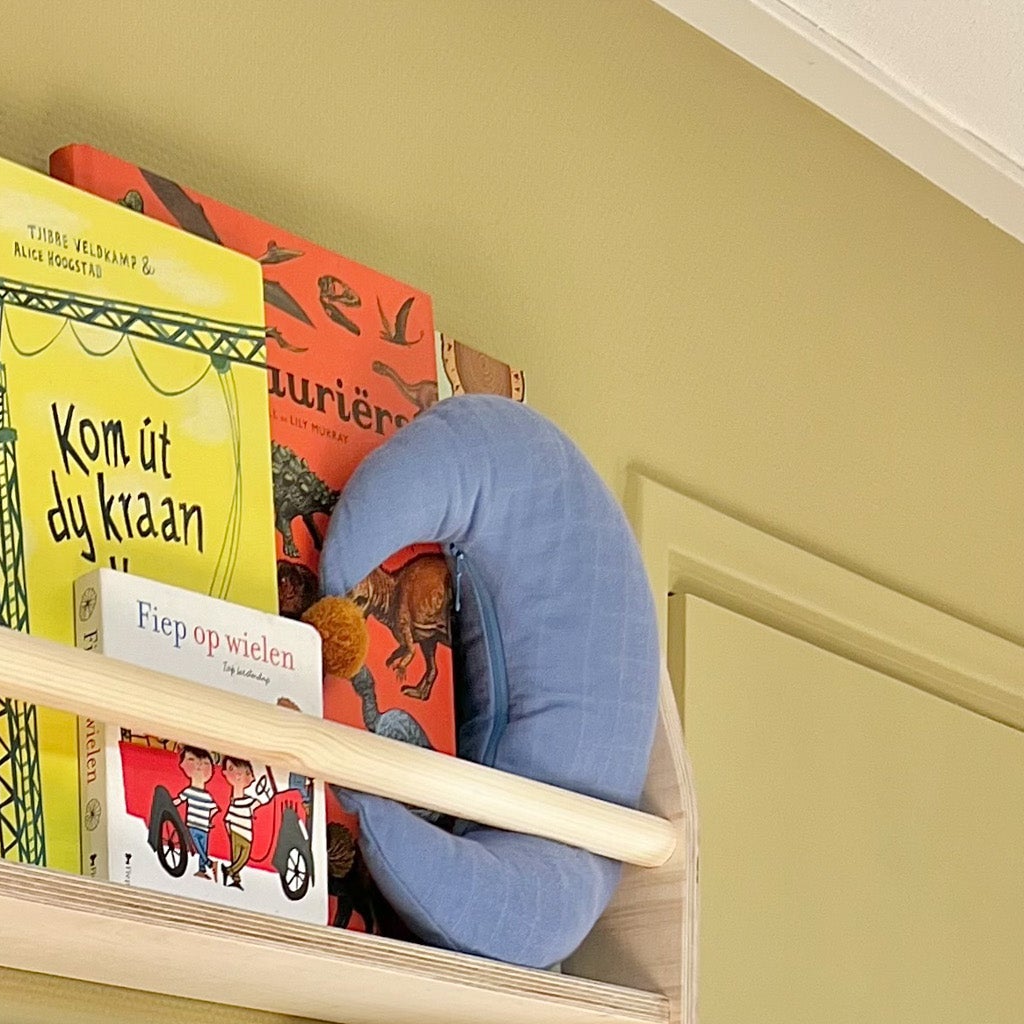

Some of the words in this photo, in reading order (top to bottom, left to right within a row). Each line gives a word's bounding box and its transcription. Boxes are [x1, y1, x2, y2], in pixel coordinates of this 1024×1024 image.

[14, 242, 43, 262] ALICE
[48, 252, 102, 279] HOOGSTAD
[27, 225, 68, 249] TJIBBE
[74, 238, 137, 269] VELDKAMP
[141, 256, 155, 275] &
[51, 402, 130, 477] Kom
[290, 416, 308, 429] LILY
[311, 422, 349, 444] MURRAY
[47, 470, 96, 563] dy
[97, 472, 203, 554] kraan
[136, 599, 187, 649] Fiep
[193, 625, 220, 658] op
[225, 632, 295, 670] wielen
